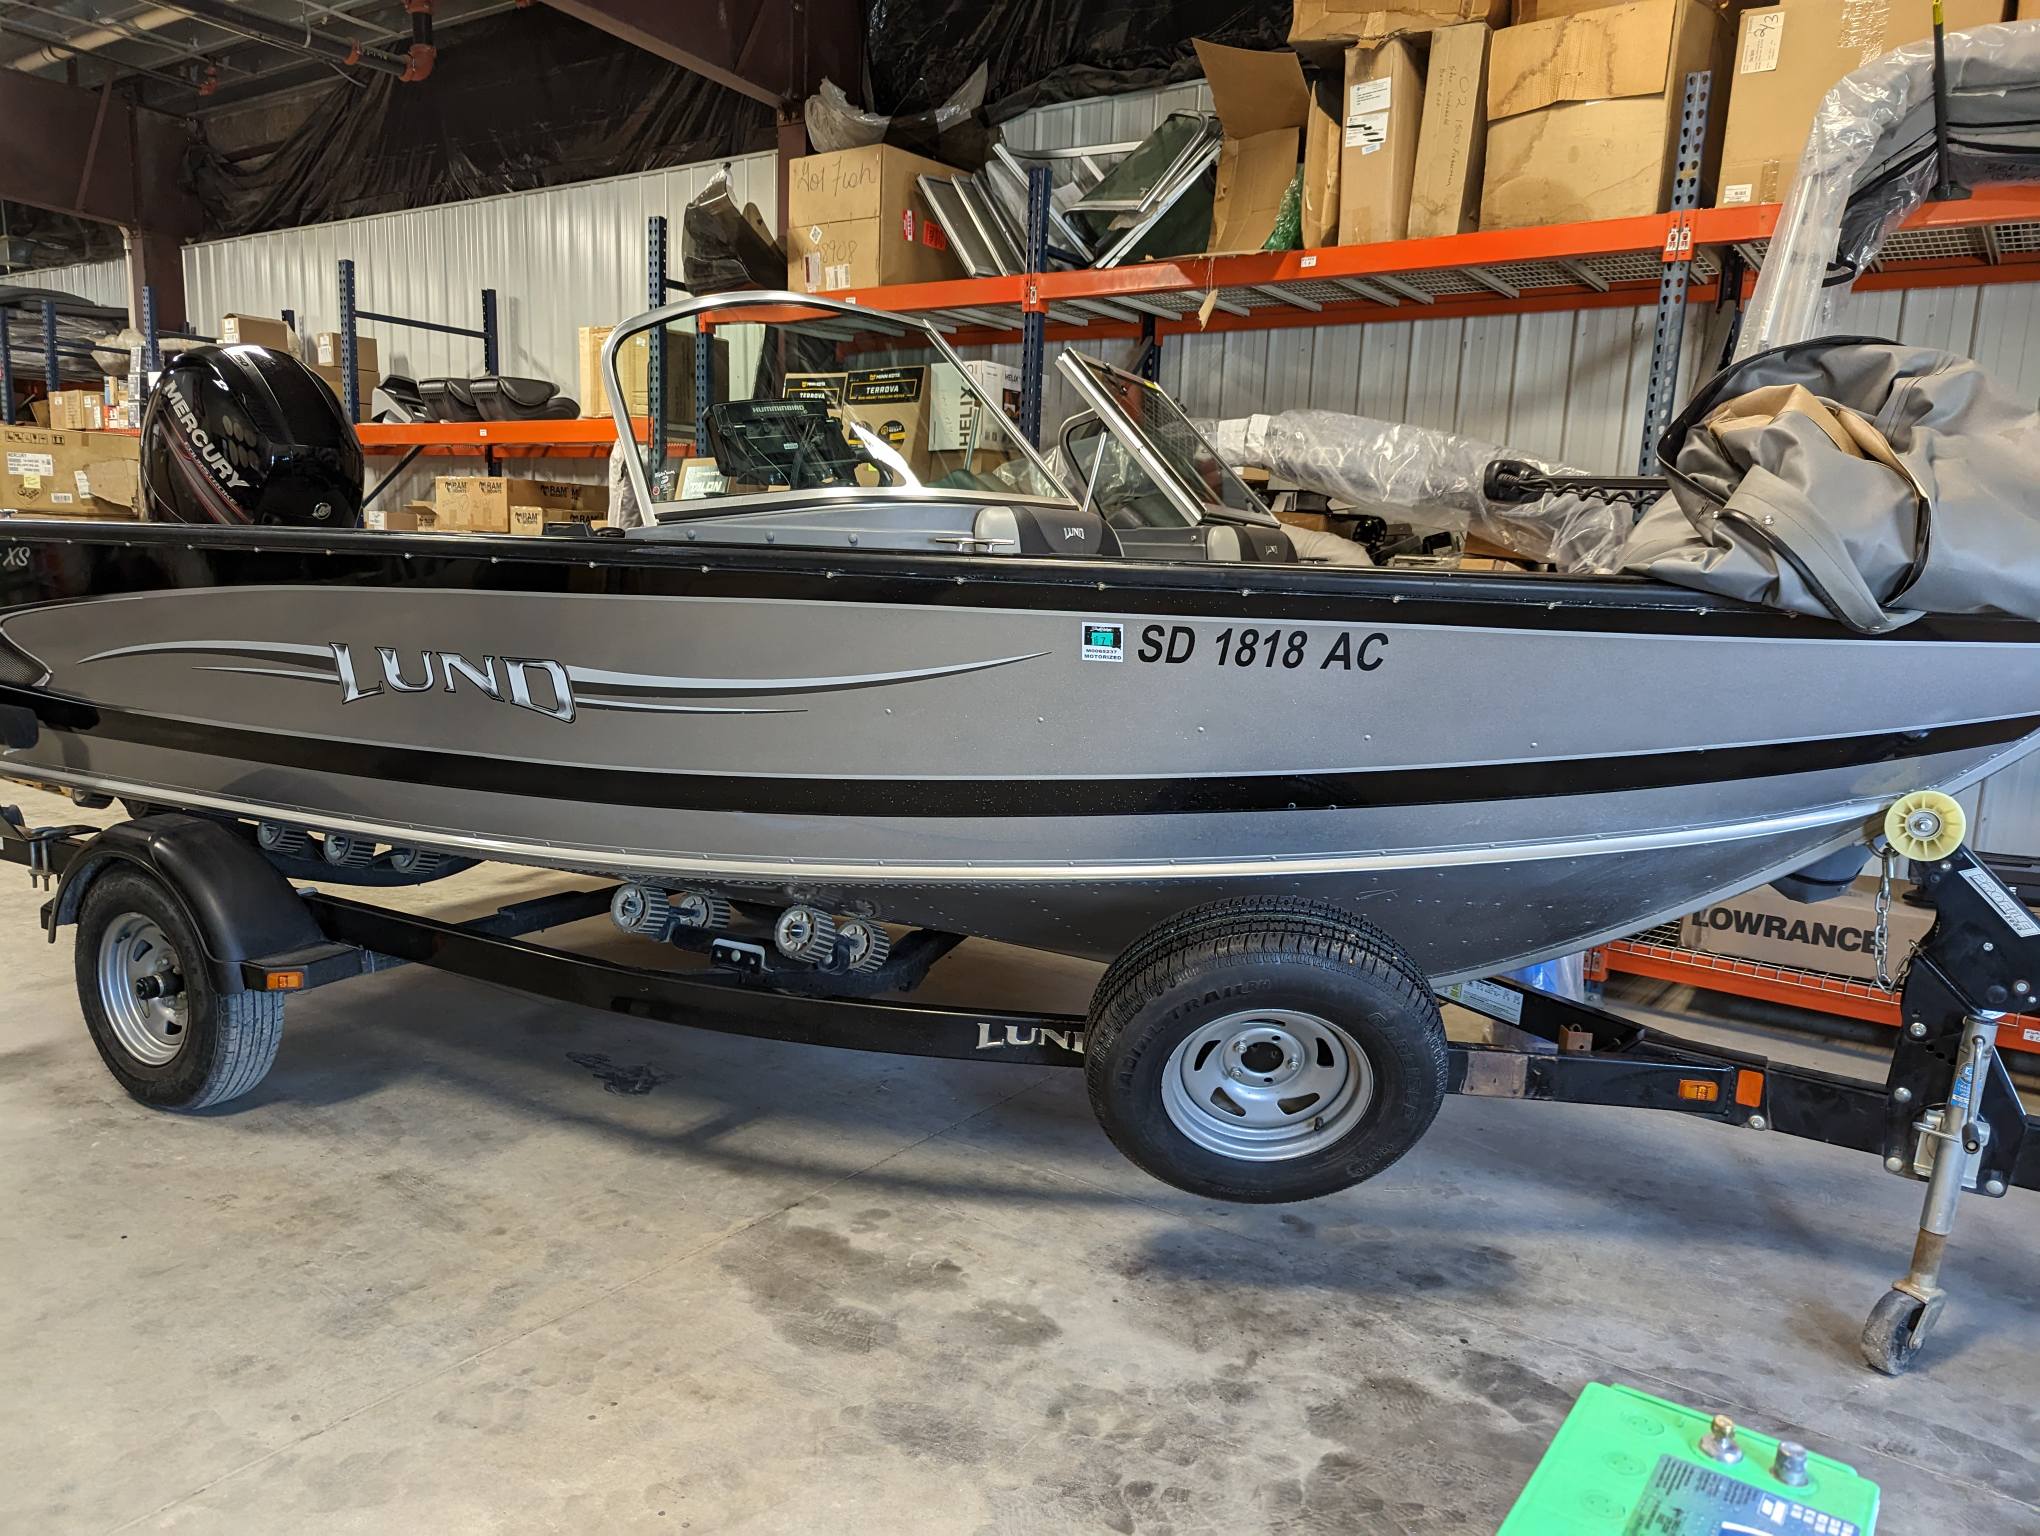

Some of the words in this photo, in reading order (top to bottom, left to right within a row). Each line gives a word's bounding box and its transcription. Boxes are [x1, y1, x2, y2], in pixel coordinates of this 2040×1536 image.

[866, 385, 899, 395] TERROVA
[752, 404, 805, 413] HUMMINBIRD
[959, 386, 976, 447] HELIX
[164, 380, 250, 488] MERCURY
[451, 481, 467, 489] RAM
[486, 482, 502, 490] RAM
[550, 485, 567, 494] RAM
[522, 512, 538, 520] RAM
[1063, 527, 1085, 540] LUND
[3, 546, 31, 567] XS
[1137, 625, 1196, 664] SD
[1214, 628, 1309, 668] 1818
[1320, 632, 1389, 671] AC
[329, 641, 577, 723] LUND
[1974, 872, 2033, 931] PROFILE
[1690, 907, 1878, 954] LOWRANCE
[1167, 982, 1250, 1020] TRAIL
